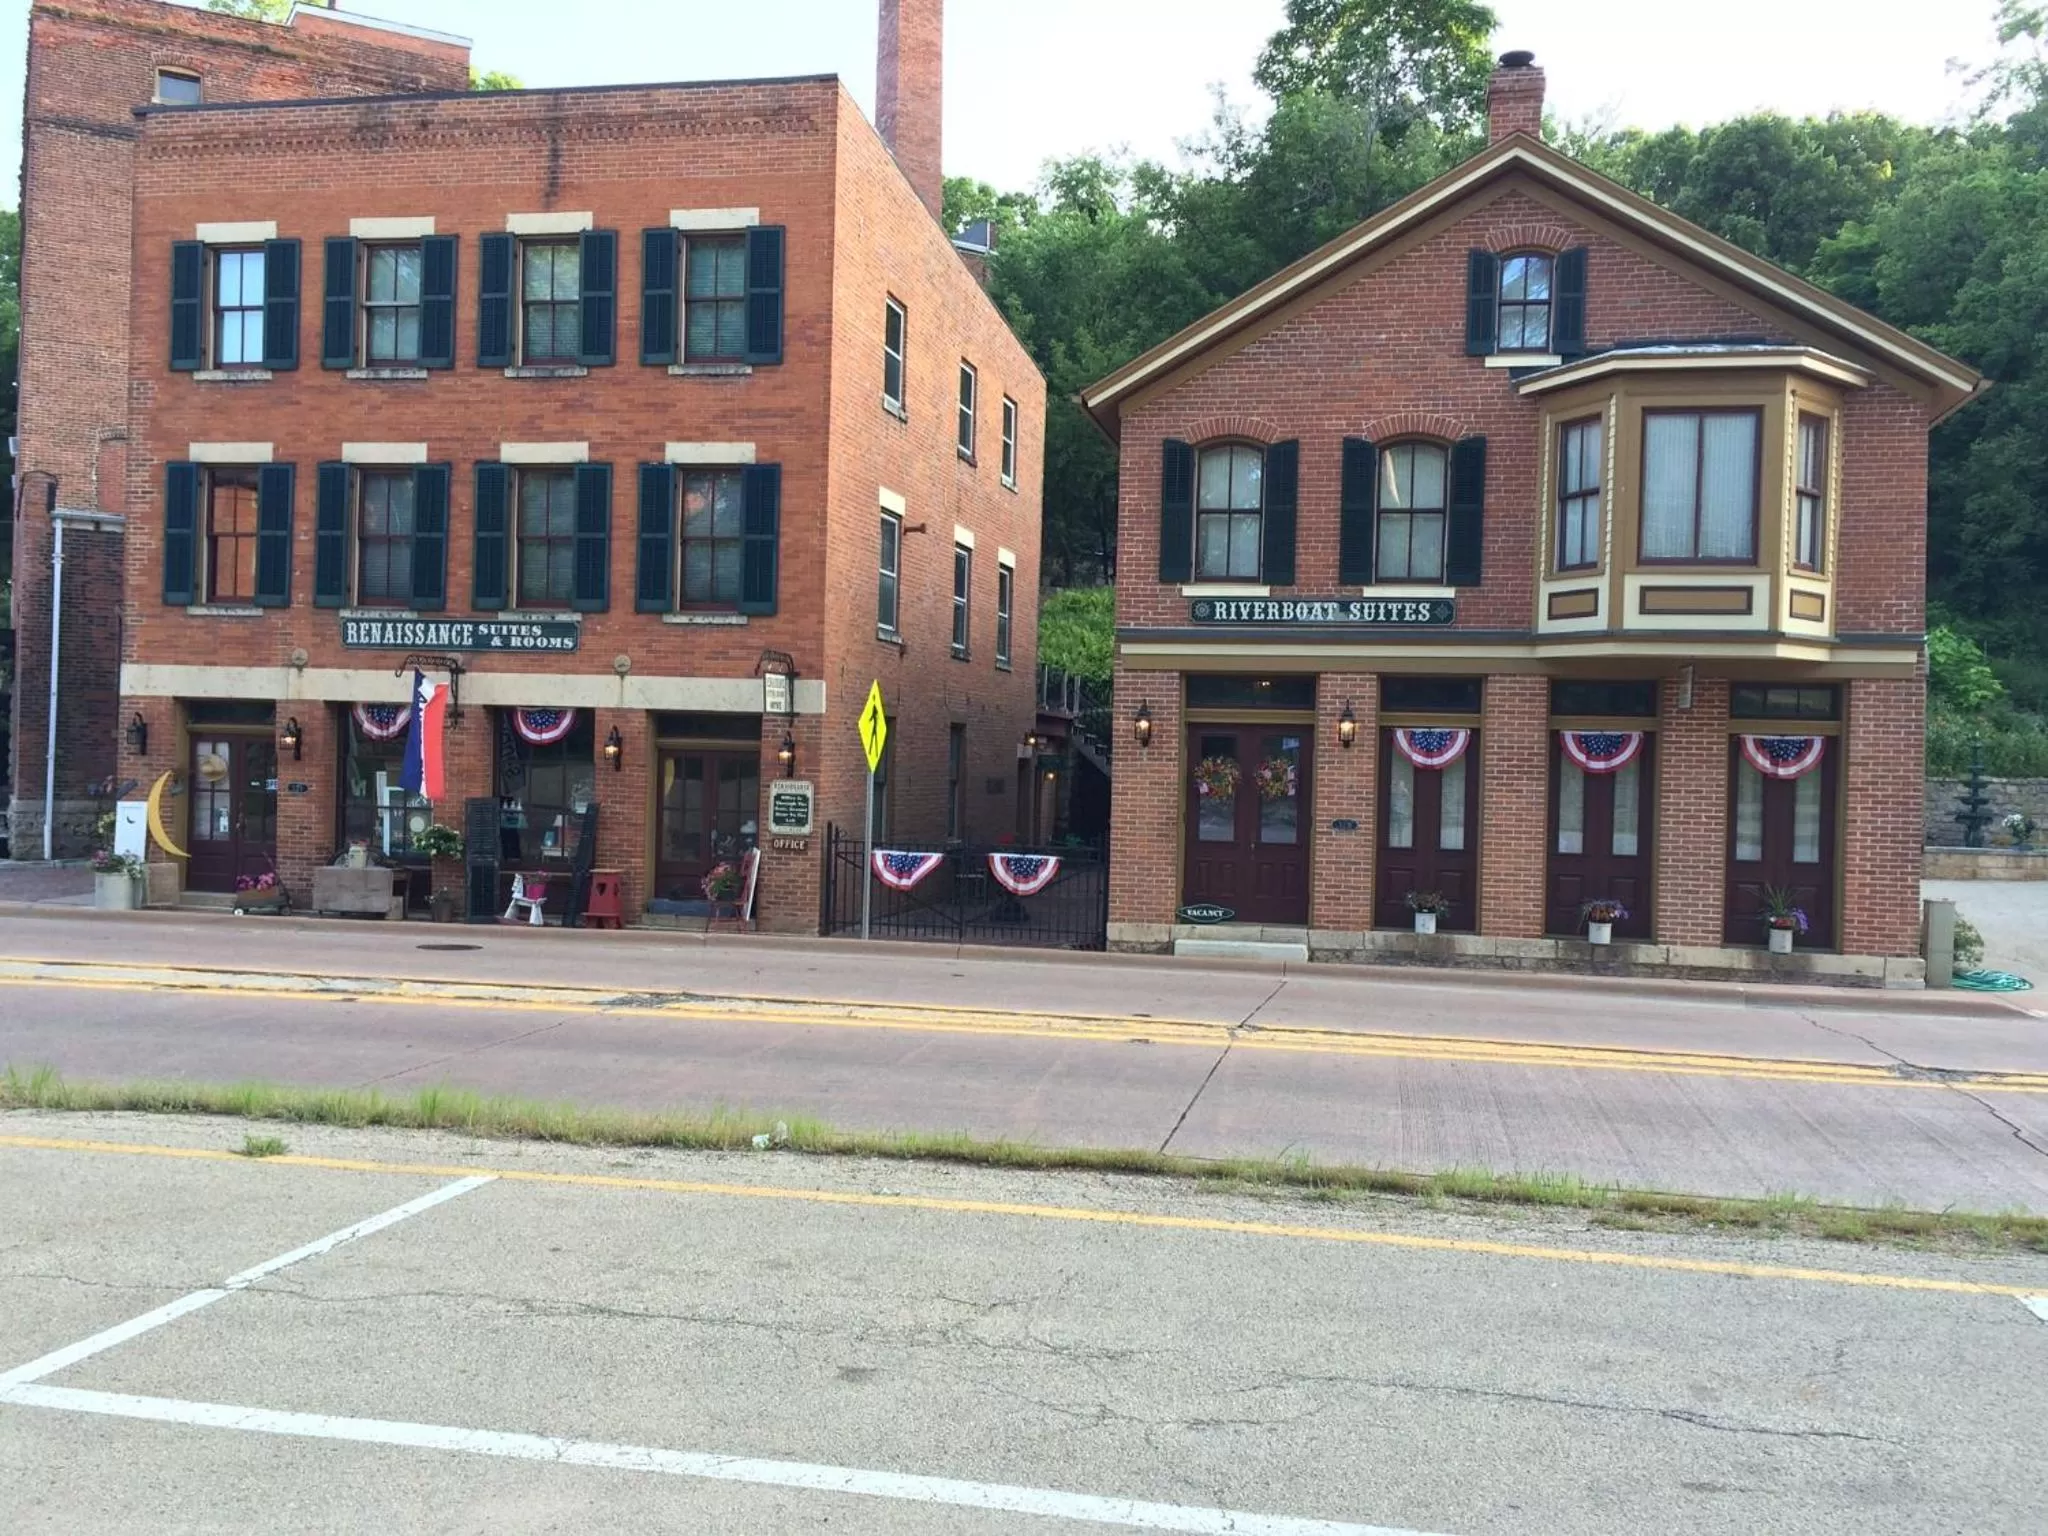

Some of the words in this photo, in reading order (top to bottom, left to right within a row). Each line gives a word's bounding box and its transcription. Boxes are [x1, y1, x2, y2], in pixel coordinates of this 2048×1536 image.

[1214, 601, 1338, 621] RIVERBOAT
[1349, 602, 1431, 622] SUITES
[346, 621, 473, 646] RENAISSANCE
[478, 623, 543, 637] SUITES
[491, 636, 503, 647] &
[510, 636, 575, 649] ROOMS
[773, 839, 805, 849] OFFICE
[1187, 909, 1224, 917] VACANCY
